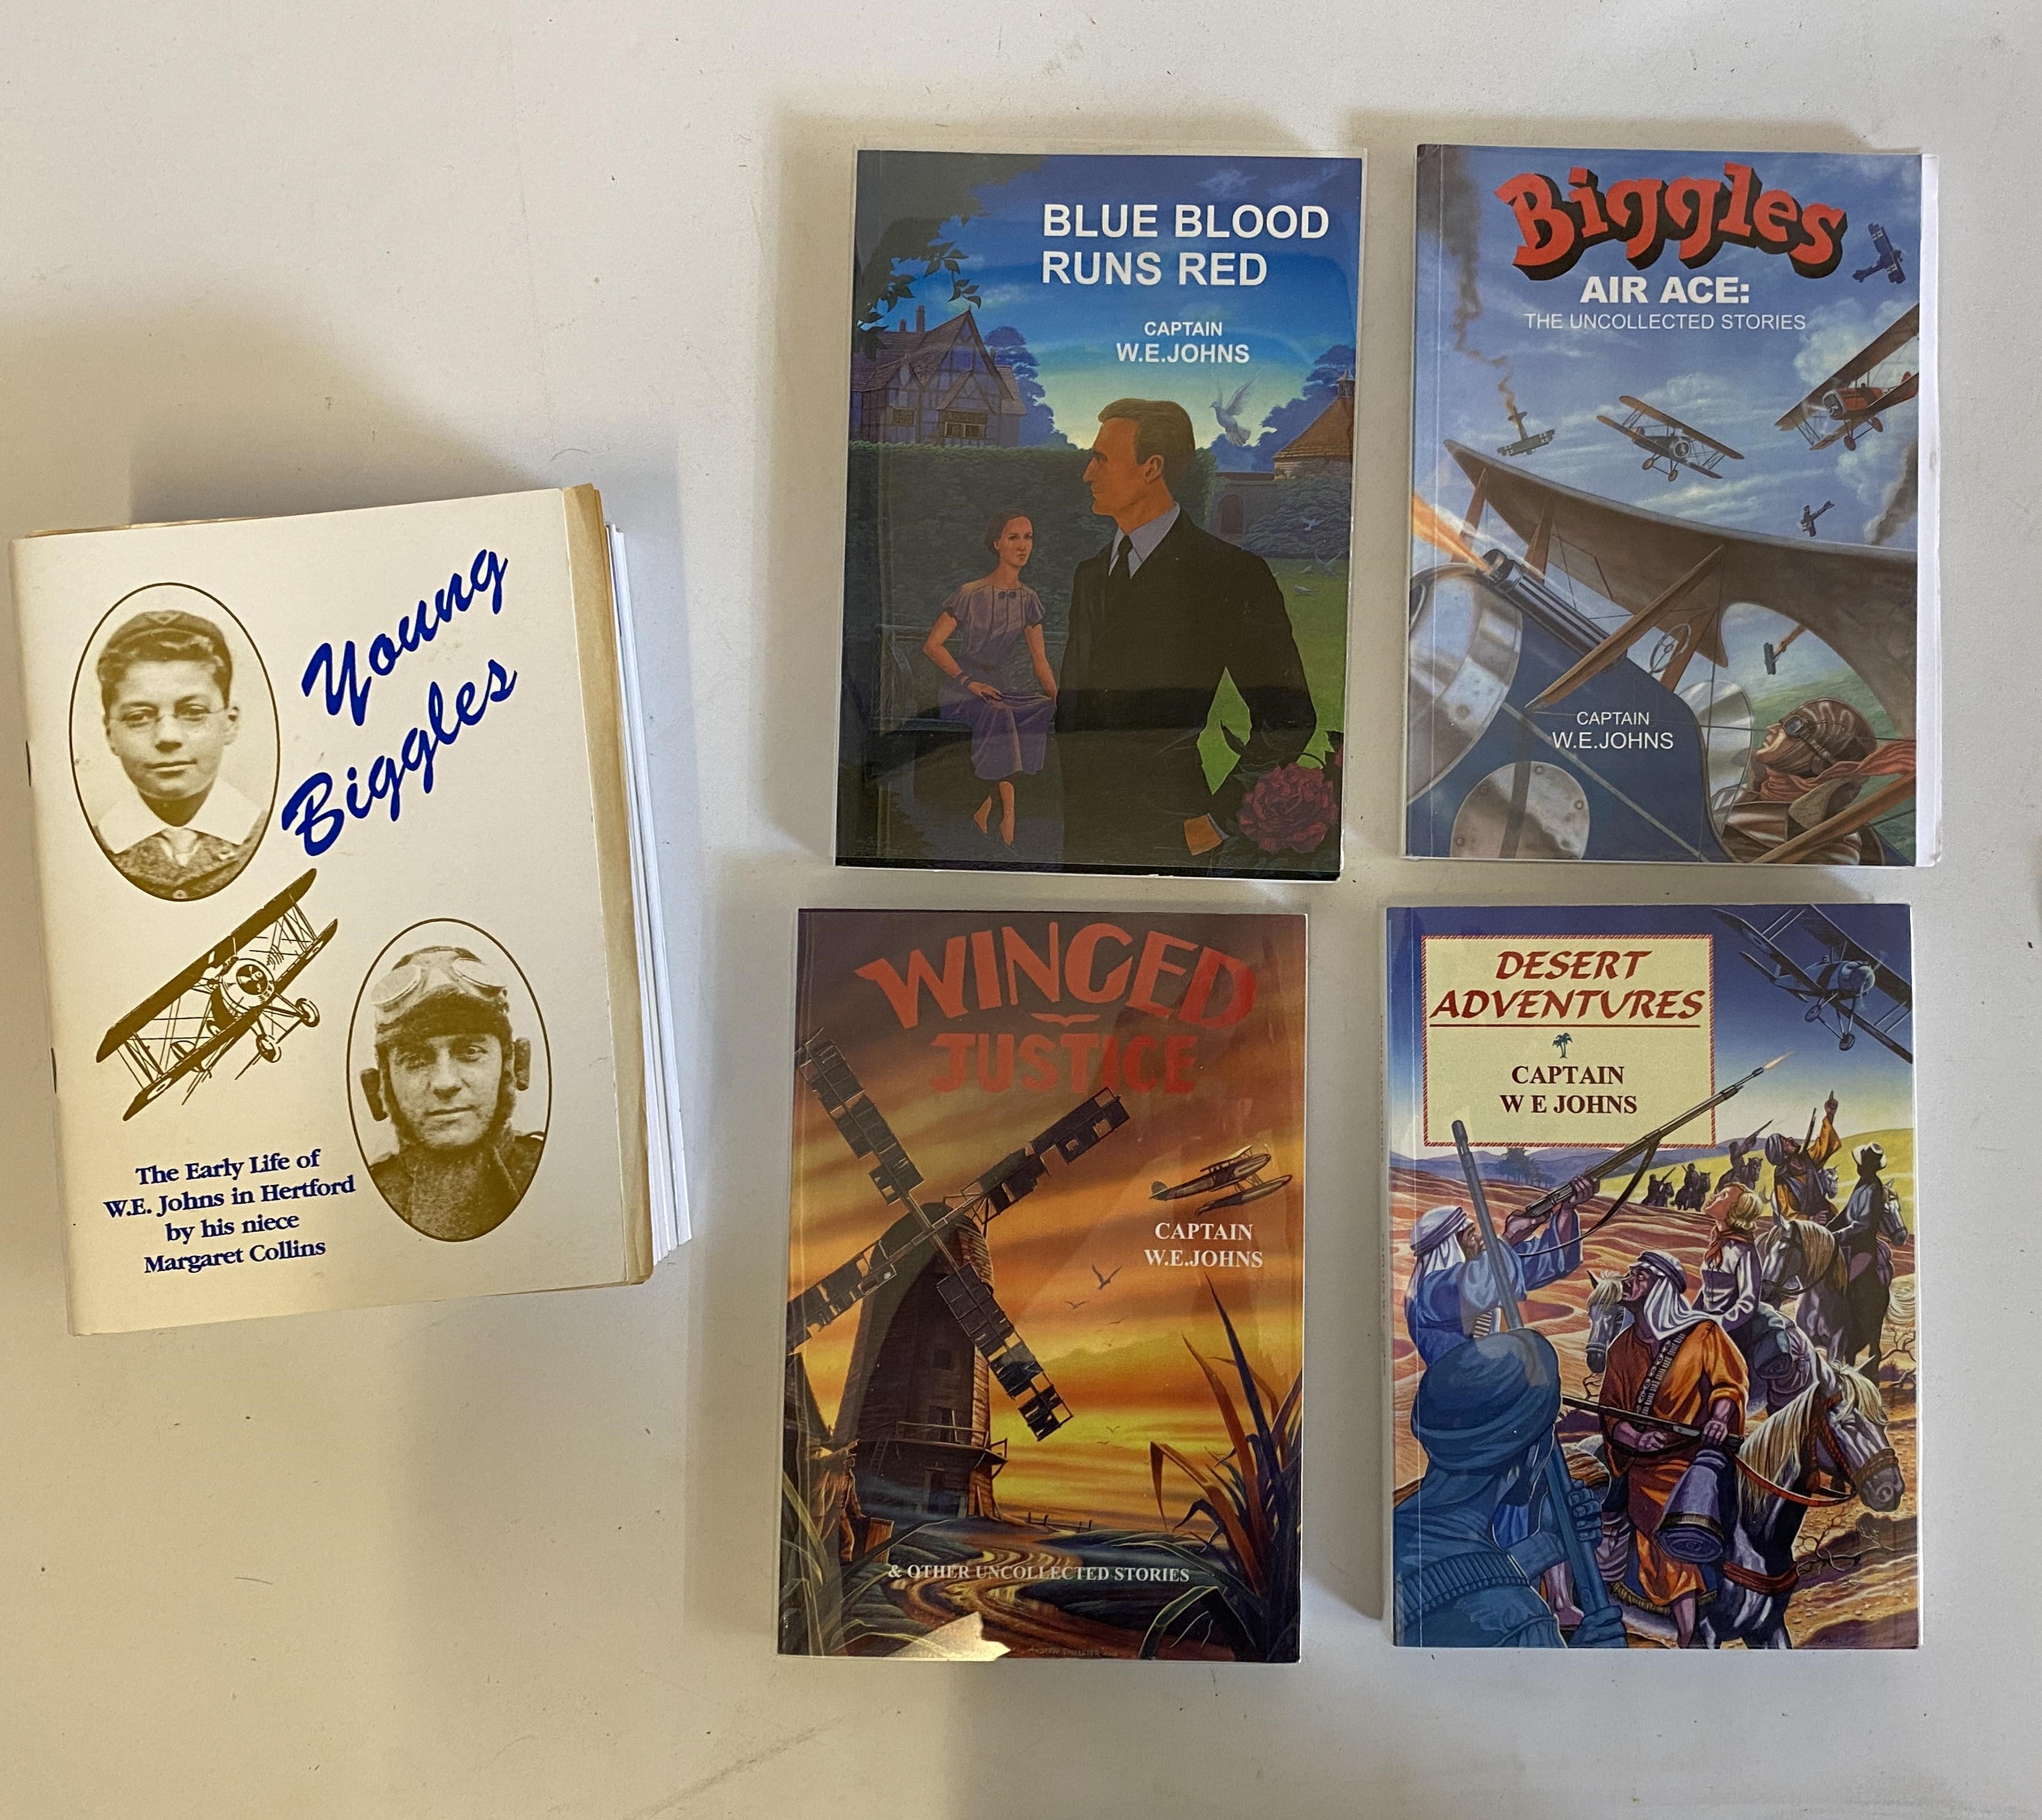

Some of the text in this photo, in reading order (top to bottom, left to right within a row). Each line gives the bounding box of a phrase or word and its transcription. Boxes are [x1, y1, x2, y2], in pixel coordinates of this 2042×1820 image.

[1043, 203, 1329, 239] BLUE BLOOD
[1495, 161, 1848, 281] Biggles
[1042, 250, 1267, 286] RUNS RED
[1580, 276, 1750, 304] AIR ACE:
[1144, 321, 1223, 337] CAPTAIN
[1524, 312, 1806, 331] THE UNCOLLECTED STORIES
[1116, 343, 1250, 364] W.E.JOHNS
[301, 549, 508, 726] Young
[1576, 711, 1649, 725] CAPTAIN
[1551, 731, 1674, 750] W.E.JOHNS
[281, 659, 518, 856] Biggles
[854, 922, 1257, 1030] WINGED
[1495, 950, 1653, 980] DESERT
[1429, 989, 1706, 1019] ADVENTURES
[930, 1033, 1199, 1094] JUSTICE
[1512, 1065, 1625, 1084] CAPTAIN
[1498, 1095, 1637, 1114] W E JOHNS
[135, 1149, 321, 1185] The Early Life of
[103, 1175, 356, 1219] W.E. Johns in Hertford
[165, 1214, 300, 1244] by his niece
[1155, 1222, 1253, 1241] CAPTAIN
[144, 1238, 326, 1273] Margaret Collins
[1144, 1249, 1263, 1269] W.E.JOHNS
[888, 1564, 1190, 1583] & OTHER UNCOLLECTED STORIES
